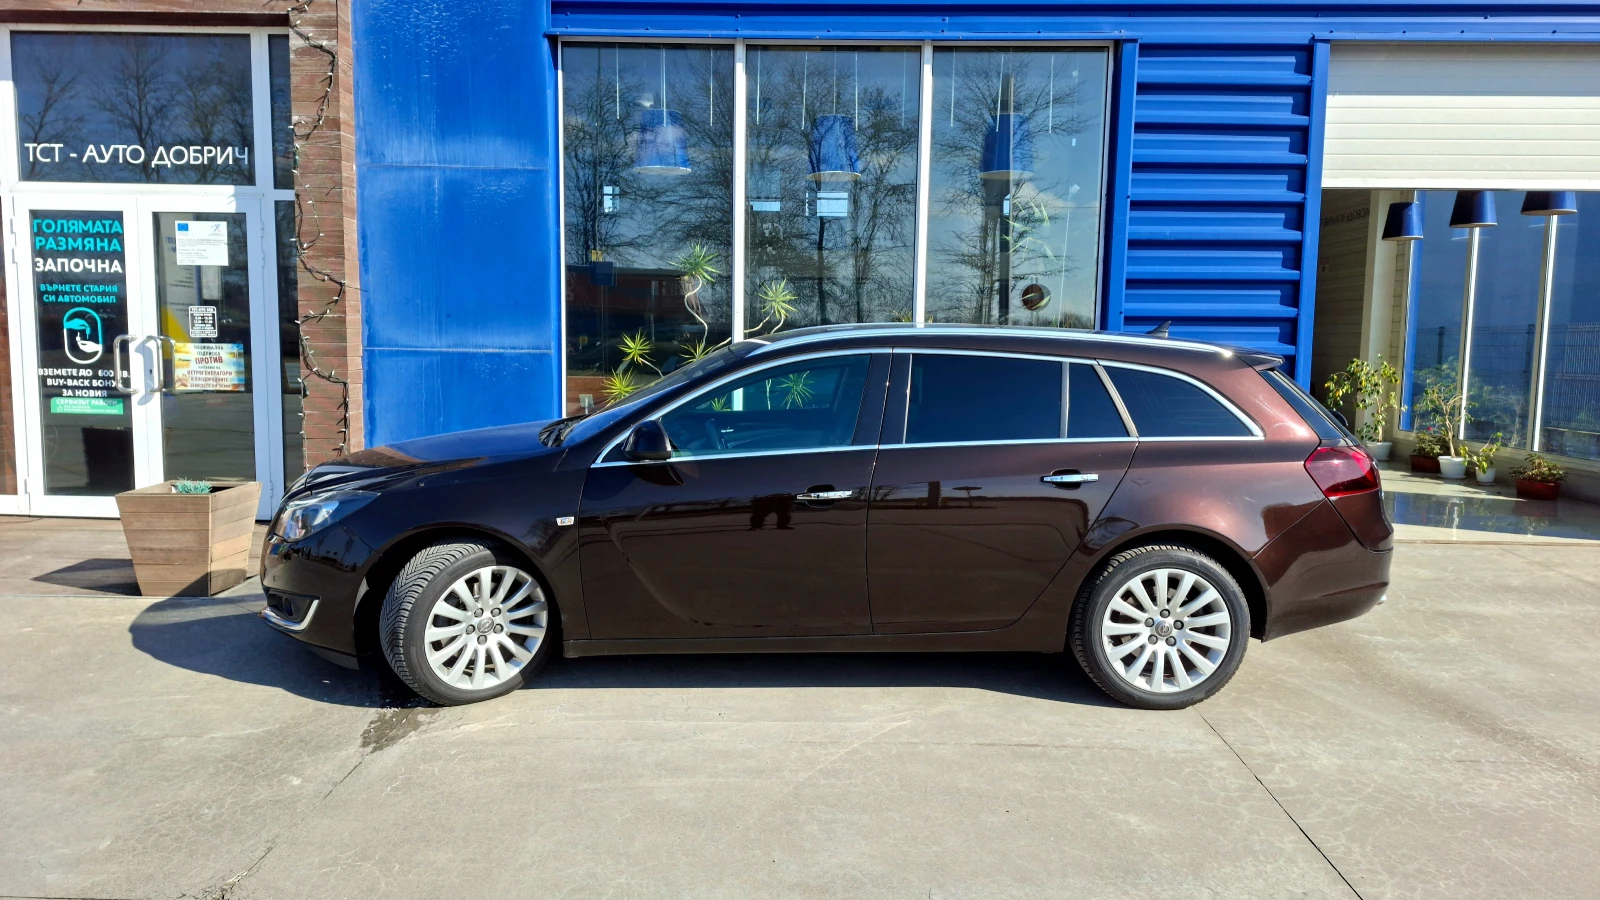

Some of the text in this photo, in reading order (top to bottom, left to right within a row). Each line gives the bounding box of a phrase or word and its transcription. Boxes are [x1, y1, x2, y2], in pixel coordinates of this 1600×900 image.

[24, 143, 64, 163] ТСТ
[82, 144, 145, 164] АУТО
[151, 146, 249, 168] ДОБРИЧ
[33, 219, 124, 234] ГОЛЯМАТА
[35, 236, 122, 252] РАЗМЯНА
[34, 257, 123, 273] ЗАПОЧНА
[40, 283, 118, 293] ВЪРНЕТЕ СТАРИЯ
[43, 294, 116, 303] СИ АВТОМОБИЛ
[195, 356, 224, 364] ПРОТИВ
[38, 368, 78, 376] ВЗЕМЕТЕ
[79, 369, 92, 377] ДО
[47, 378, 90, 387] BUY-BACK
[62, 389, 73, 397] ЗА
